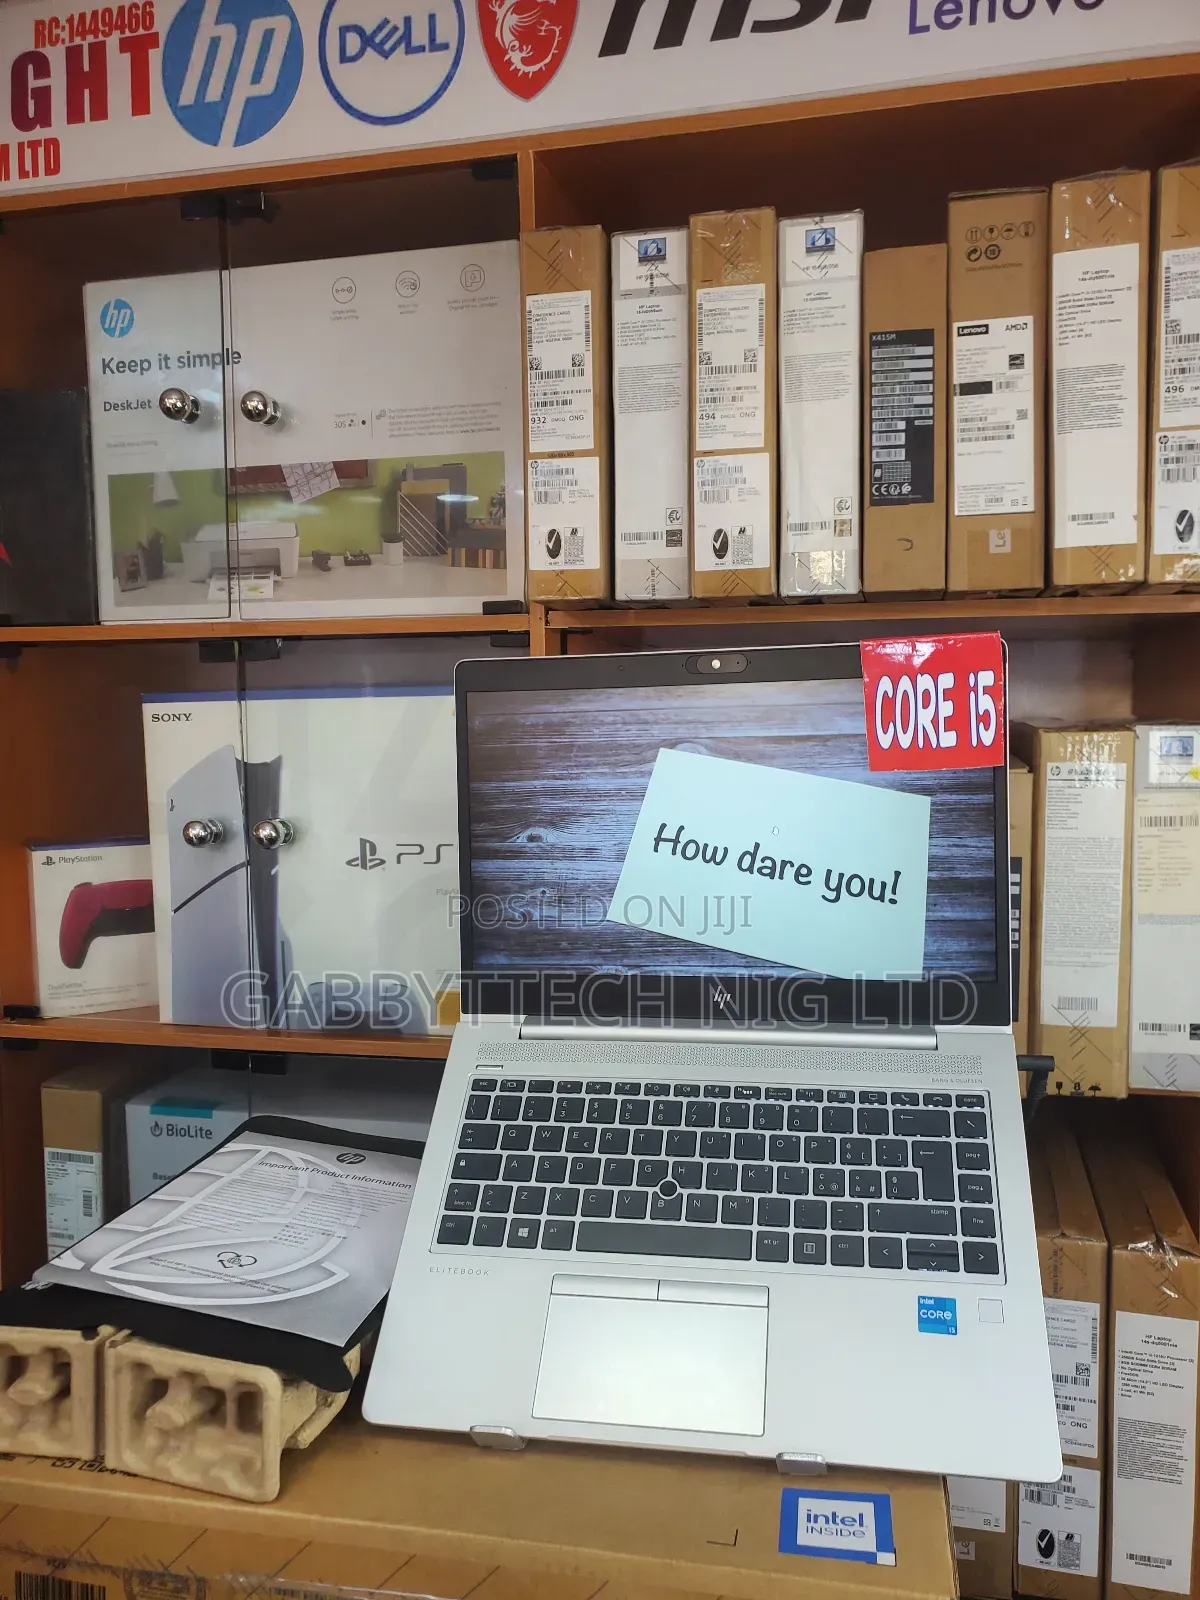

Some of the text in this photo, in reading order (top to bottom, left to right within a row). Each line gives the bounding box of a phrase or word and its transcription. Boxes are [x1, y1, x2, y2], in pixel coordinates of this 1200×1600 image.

[34, 1, 156, 49] RC:1449466
[338, 13, 449, 64] DELL
[10, 31, 160, 133] GHT
[17, 137, 61, 180] LTD
[104, 300, 131, 339] hp
[1004, 323, 1022, 332] AMD
[871, 333, 896, 341] X415M
[959, 326, 987, 335] Lenovo
[102, 347, 242, 376] Keep it simple
[1164, 384, 1185, 393] 496
[103, 400, 152, 412] DeskJet
[530, 416, 547, 425] 932
[698, 412, 716, 421] 494
[151, 713, 193, 722] SONY
[875, 670, 997, 750] CORE i5
[58, 855, 103, 865] PlayStation
[653, 823, 903, 905] How dare you!
[528, 1109, 534, 1117] 2
[560, 1110, 566, 1118] 3
[625, 1112, 631, 1120] 5
[691, 1114, 697, 1122] 7
[725, 1116, 731, 1124] 8
[759, 1117, 765, 1125] 9
[166, 1123, 213, 1140] BioLite
[508, 1129, 517, 1138] Q
[541, 1130, 551, 1138] W
[572, 1131, 580, 1139] E
[605, 1132, 613, 1140] R
[638, 1133, 645, 1141] T
[673, 1135, 680, 1143] Y
[706, 1136, 713, 1144] U
[810, 1141, 818, 1149] P
[258, 1160, 412, 1190] Important Product Information
[510, 1160, 790, 1180] A S D F G H J K L
[521, 1192, 528, 1200] Z
[554, 1193, 562, 1201] X
[589, 1195, 596, 1203] C
[623, 1196, 631, 1204] V
[693, 1199, 700, 1207] N
[729, 1201, 738, 1209] M
[930, 1208, 949, 1216] stamp
[429, 1266, 490, 1276] ELITEBOOK
[1070, 1421, 1088, 1429] ONG
[806, 1509, 864, 1527] intel
